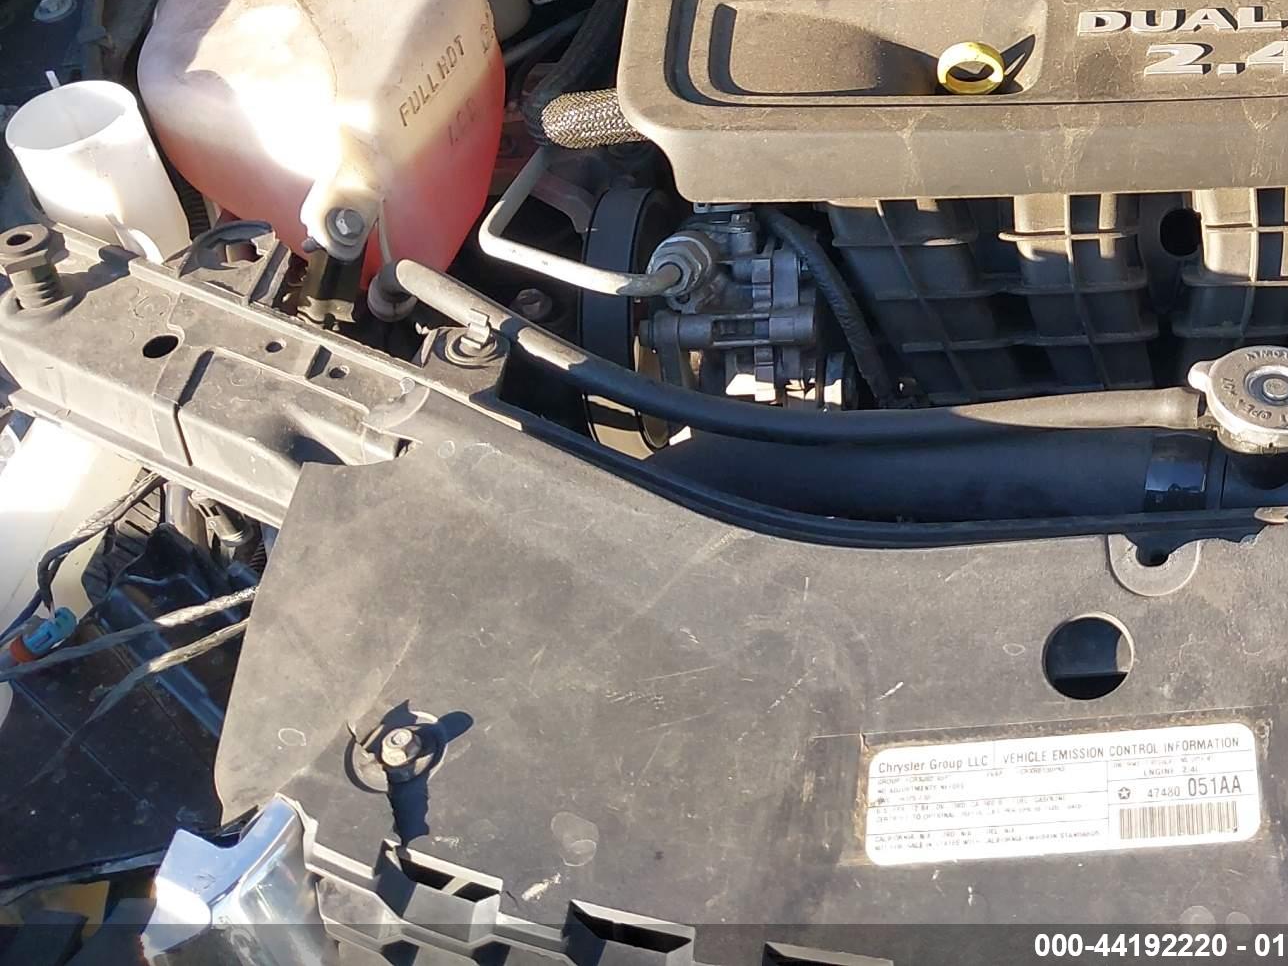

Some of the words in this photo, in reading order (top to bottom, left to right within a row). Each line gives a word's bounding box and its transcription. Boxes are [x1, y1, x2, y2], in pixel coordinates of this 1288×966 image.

[398, 73, 439, 128] FULL
[436, 34, 466, 80] HOT
[878, 761, 926, 774] Chrysler
[929, 758, 963, 772] Group
[967, 754, 989, 767] LLC
[1003, 750, 1048, 765] VEHICLE
[1052, 746, 1104, 761] EMISSION
[1109, 742, 1159, 757] CONTROL
[1163, 737, 1240, 753] INFORMATION
[1146, 785, 1181, 799] 47480
[1187, 774, 1243, 797] 051AA
